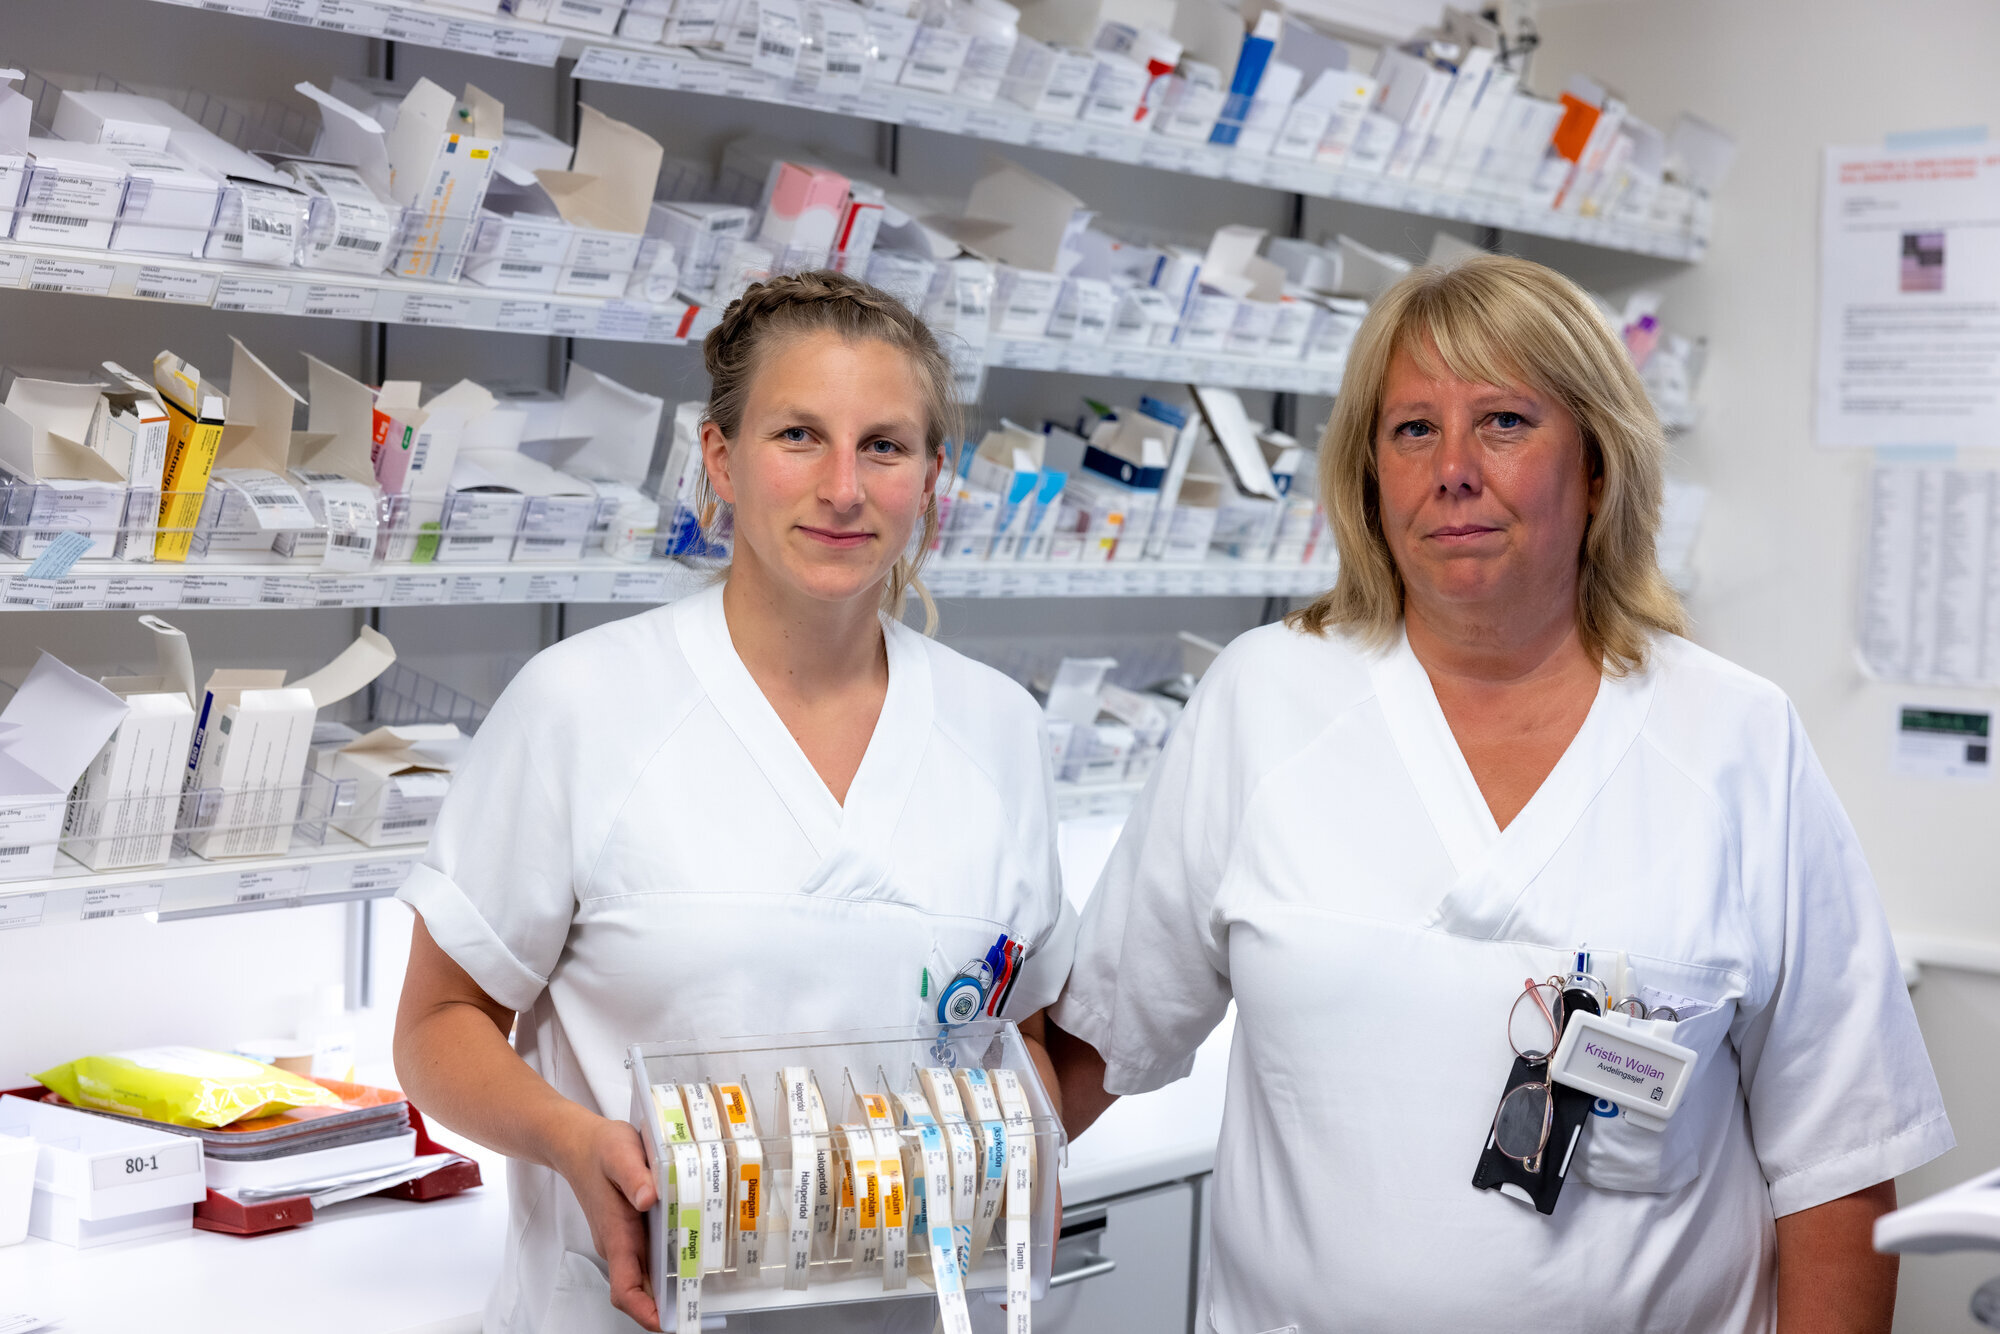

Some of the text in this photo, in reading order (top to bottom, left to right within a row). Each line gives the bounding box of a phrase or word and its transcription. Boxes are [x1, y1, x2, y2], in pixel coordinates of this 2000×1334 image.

[160, 498, 168, 515] 50
[190, 728, 204, 766] 150 mg
[64, 786, 78, 832] Lyrica
[1584, 1042, 1665, 1080] Kristin Wollan
[1597, 1062, 1645, 1084] Avdelingssjef
[795, 1082, 805, 1112] Haloperidol
[126, 1154, 158, 1174] 80-1
[816, 1148, 828, 1196] Haloperidol
[748, 1178, 758, 1219] Diazepam
[800, 1171, 811, 1220] Haloperidol
[866, 1171, 878, 1218] Midazolam
[688, 1229, 698, 1260] Atropin
[1016, 1242, 1026, 1270] Tiamin
